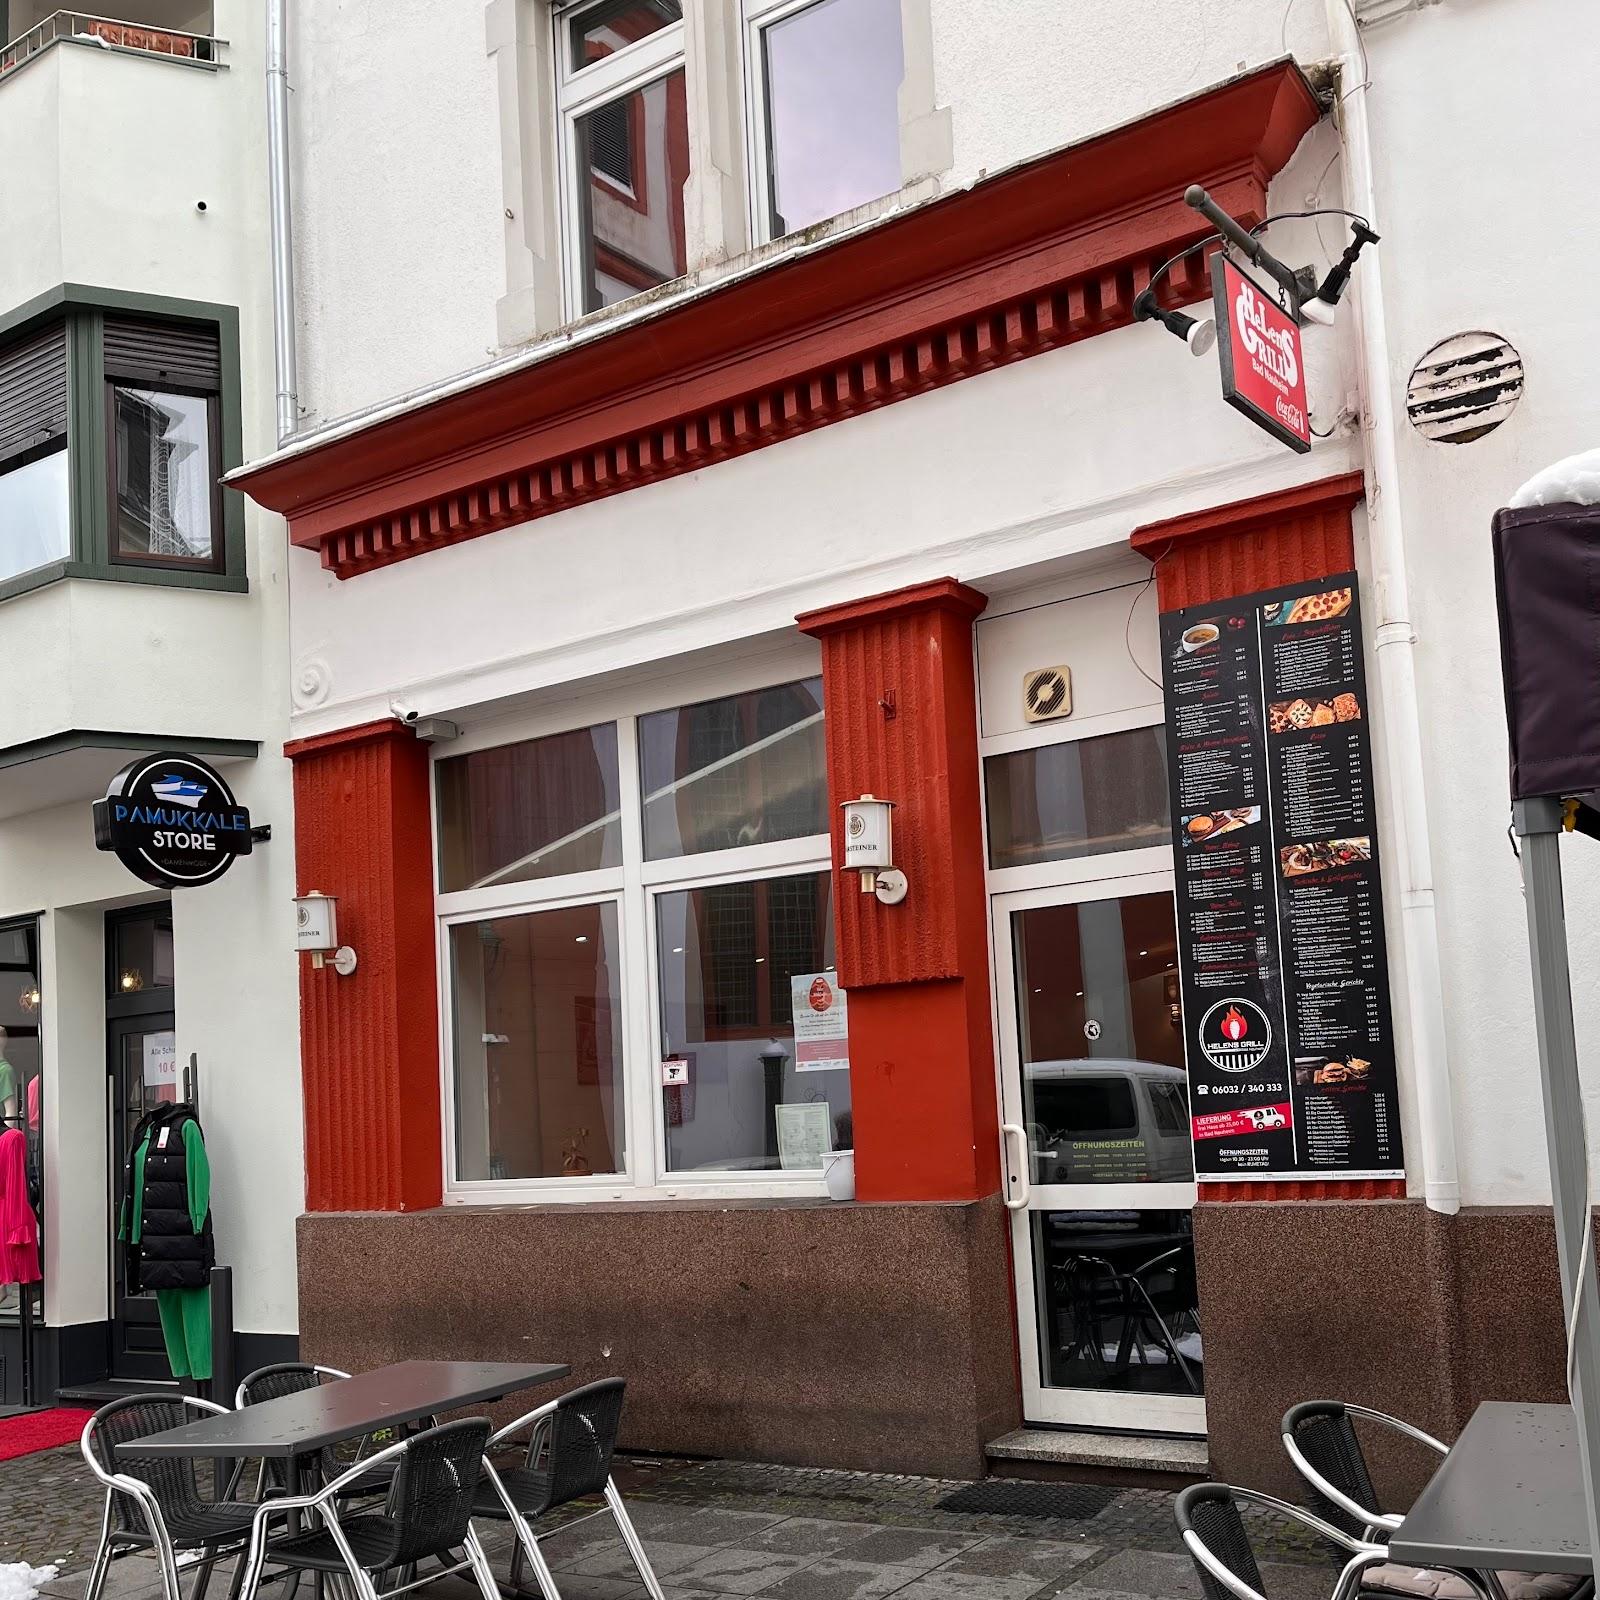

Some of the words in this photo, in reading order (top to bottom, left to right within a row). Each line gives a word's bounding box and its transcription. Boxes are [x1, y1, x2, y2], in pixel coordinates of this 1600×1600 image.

[1252, 358, 1264, 377] Bad
[1265, 366, 1289, 396] Nauheim
[115, 804, 246, 832] PAMUKKALE
[153, 830, 216, 850] STORE
[1207, 1041, 1239, 1050] HELENS
[151, 1048, 161, 1056] Alle
[158, 1062, 167, 1073] 10
[1212, 1085, 1239, 1094] 06032
[1241, 1084, 1245, 1093] /
[1248, 1084, 1264, 1092] 340
[1267, 1083, 1282, 1092] 333
[1197, 1114, 1232, 1125] LIEFERUNG
